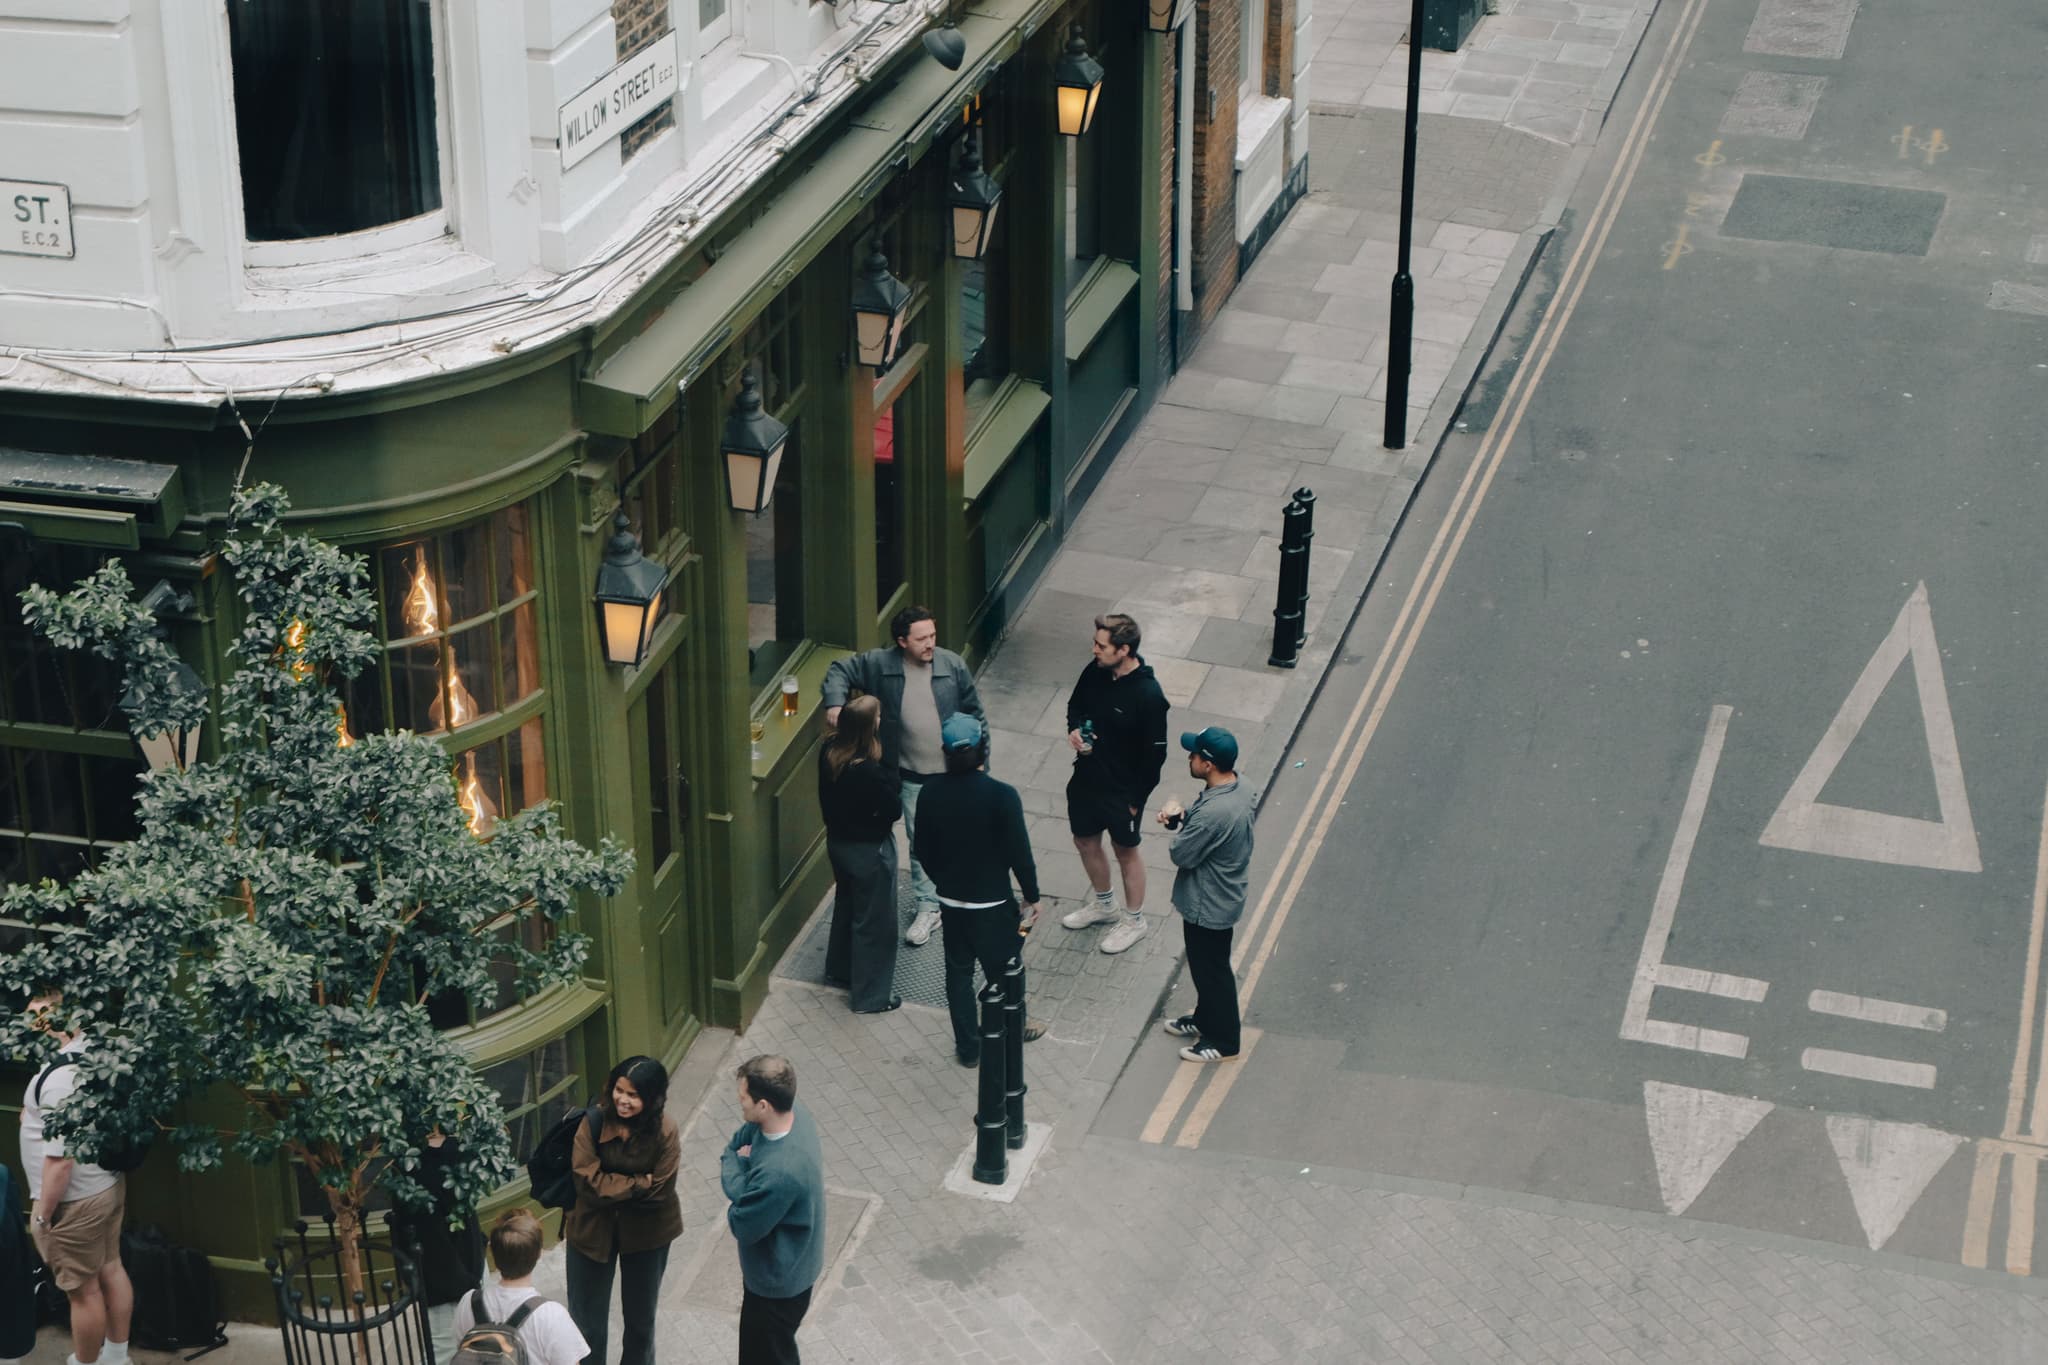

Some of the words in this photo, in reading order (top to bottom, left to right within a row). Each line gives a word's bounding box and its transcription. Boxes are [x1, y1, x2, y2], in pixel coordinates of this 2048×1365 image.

[566, 98, 607, 149] WILLOW
[612, 62, 656, 115] STREET
[14, 194, 60, 225] ST.
[21, 229, 61, 248] E.C.2
